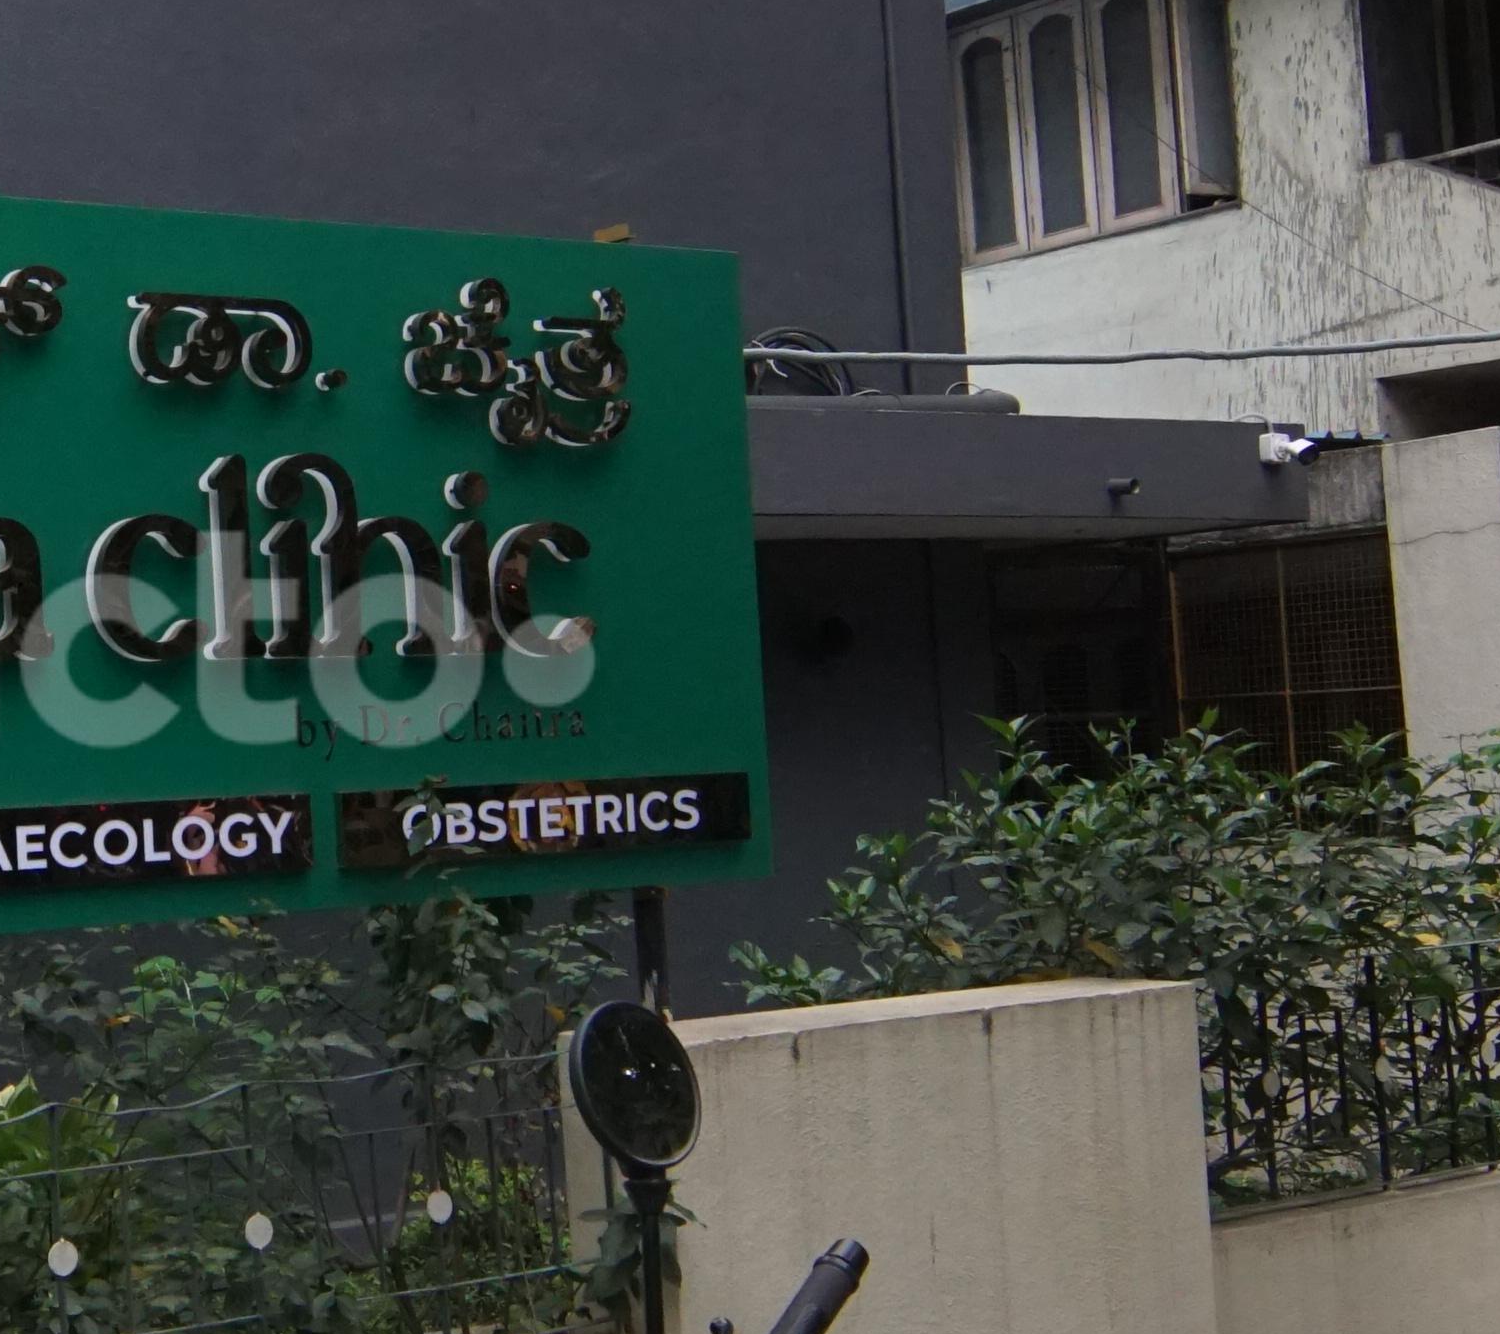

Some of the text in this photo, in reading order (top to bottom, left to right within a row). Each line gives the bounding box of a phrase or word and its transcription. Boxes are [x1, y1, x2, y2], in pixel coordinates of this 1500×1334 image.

[126, 292, 348, 393] ಡಾ.
[85, 452, 597, 662] clinic
[294, 703, 341, 762] by
[358, 703, 421, 747] Dr.
[402, 789, 702, 848] OBSTETRICS
